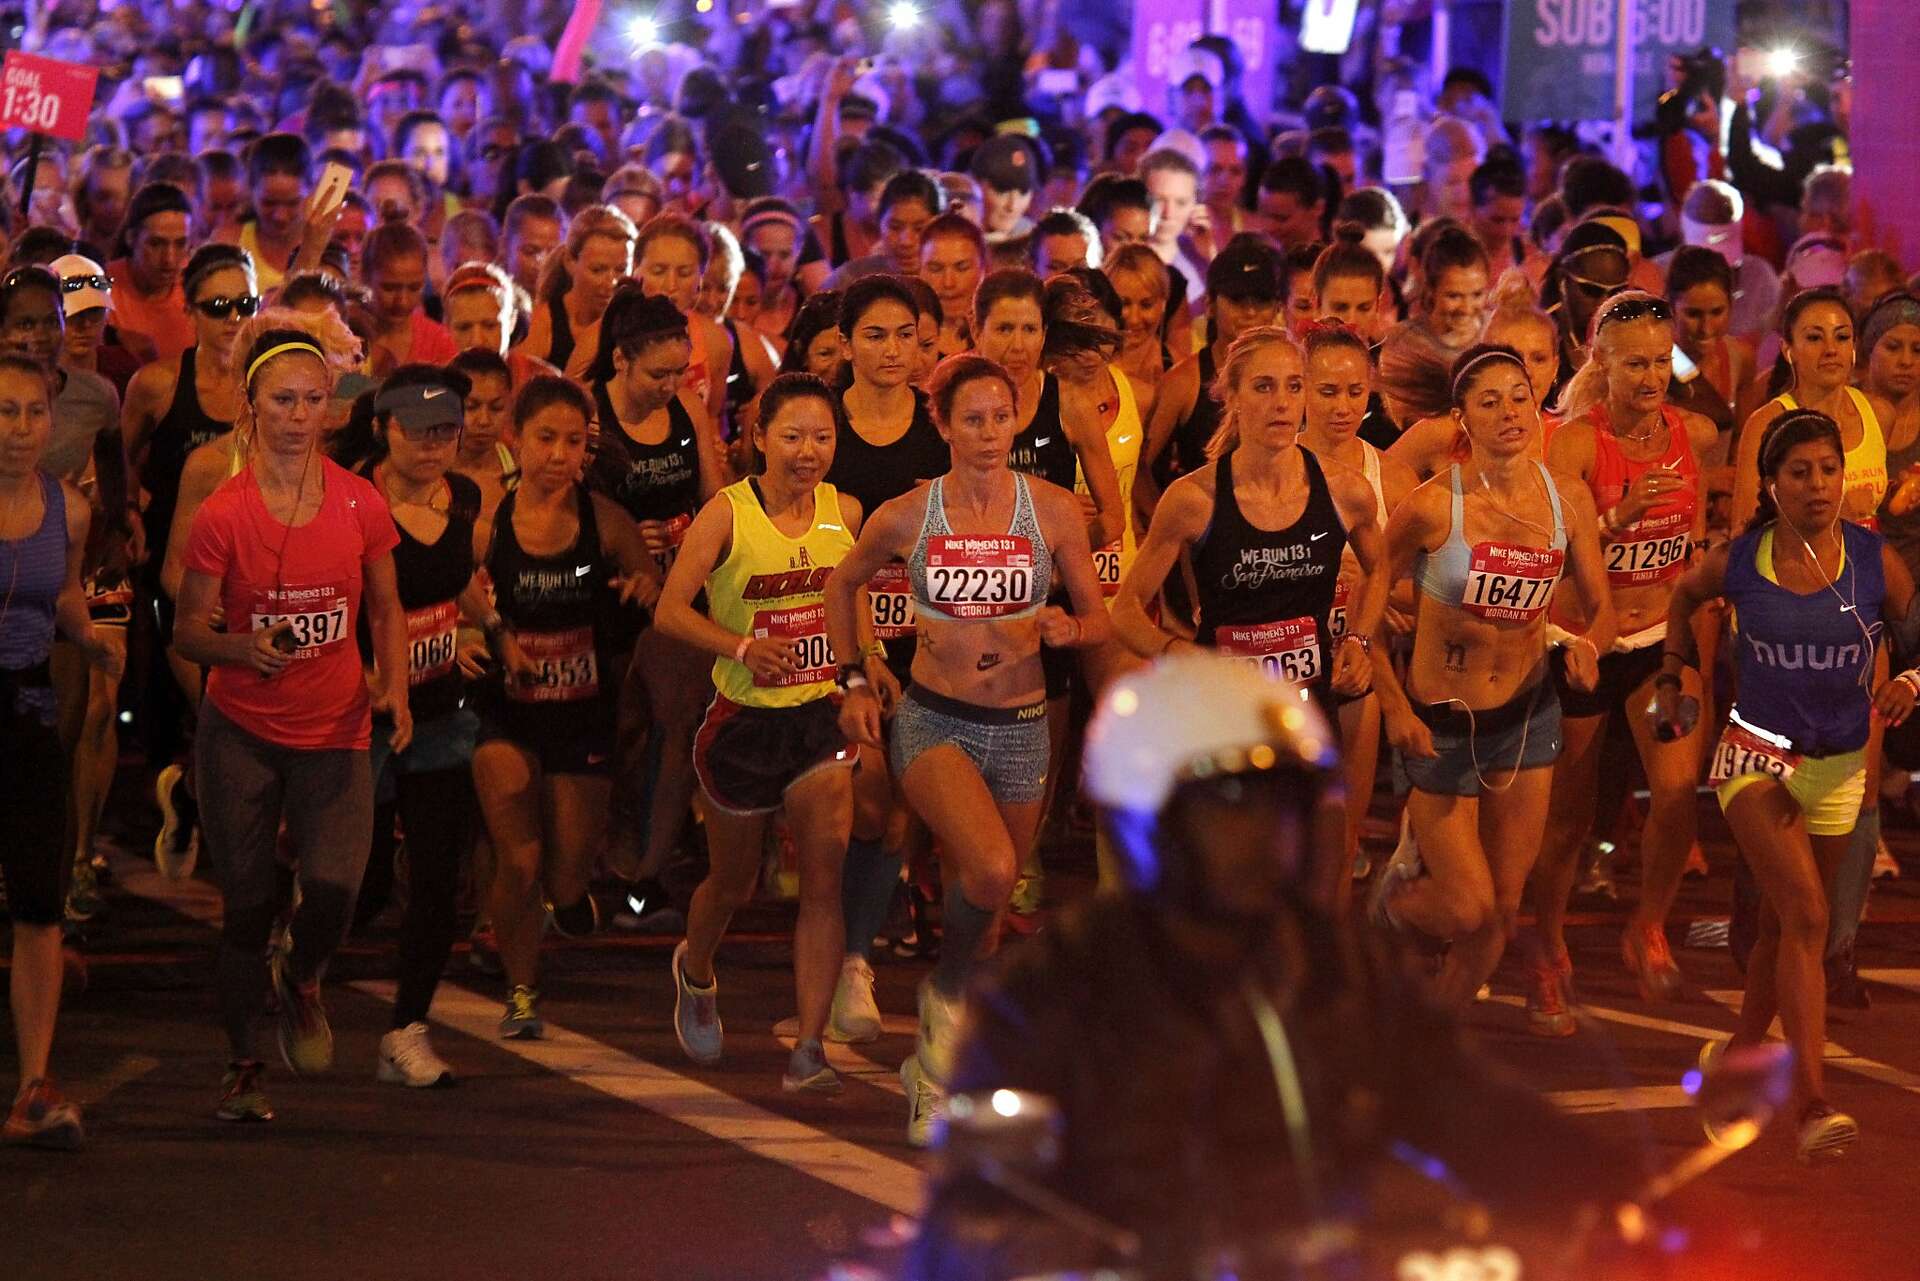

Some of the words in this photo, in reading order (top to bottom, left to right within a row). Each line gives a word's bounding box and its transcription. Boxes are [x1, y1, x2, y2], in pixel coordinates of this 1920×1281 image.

[1536, 0, 1611, 45] SUB
[6, 67, 41, 90] GOAL
[3, 86, 59, 129] 1:30
[945, 540, 964, 549] NIKE
[1241, 549, 1259, 564] WE
[1262, 547, 1288, 562] RUN
[1490, 546, 1507, 558] NIKE
[1608, 535, 1684, 571] 21296
[1095, 553, 1120, 582] 26
[933, 568, 1027, 602] 22230
[1475, 573, 1554, 609] 16477
[771, 614, 788, 624] NIKE
[953, 605, 991, 616] VICTORIA
[1485, 608, 1518, 619] MORGAN
[1232, 631, 1250, 641] NIKE
[1746, 632, 1860, 670] nuun
